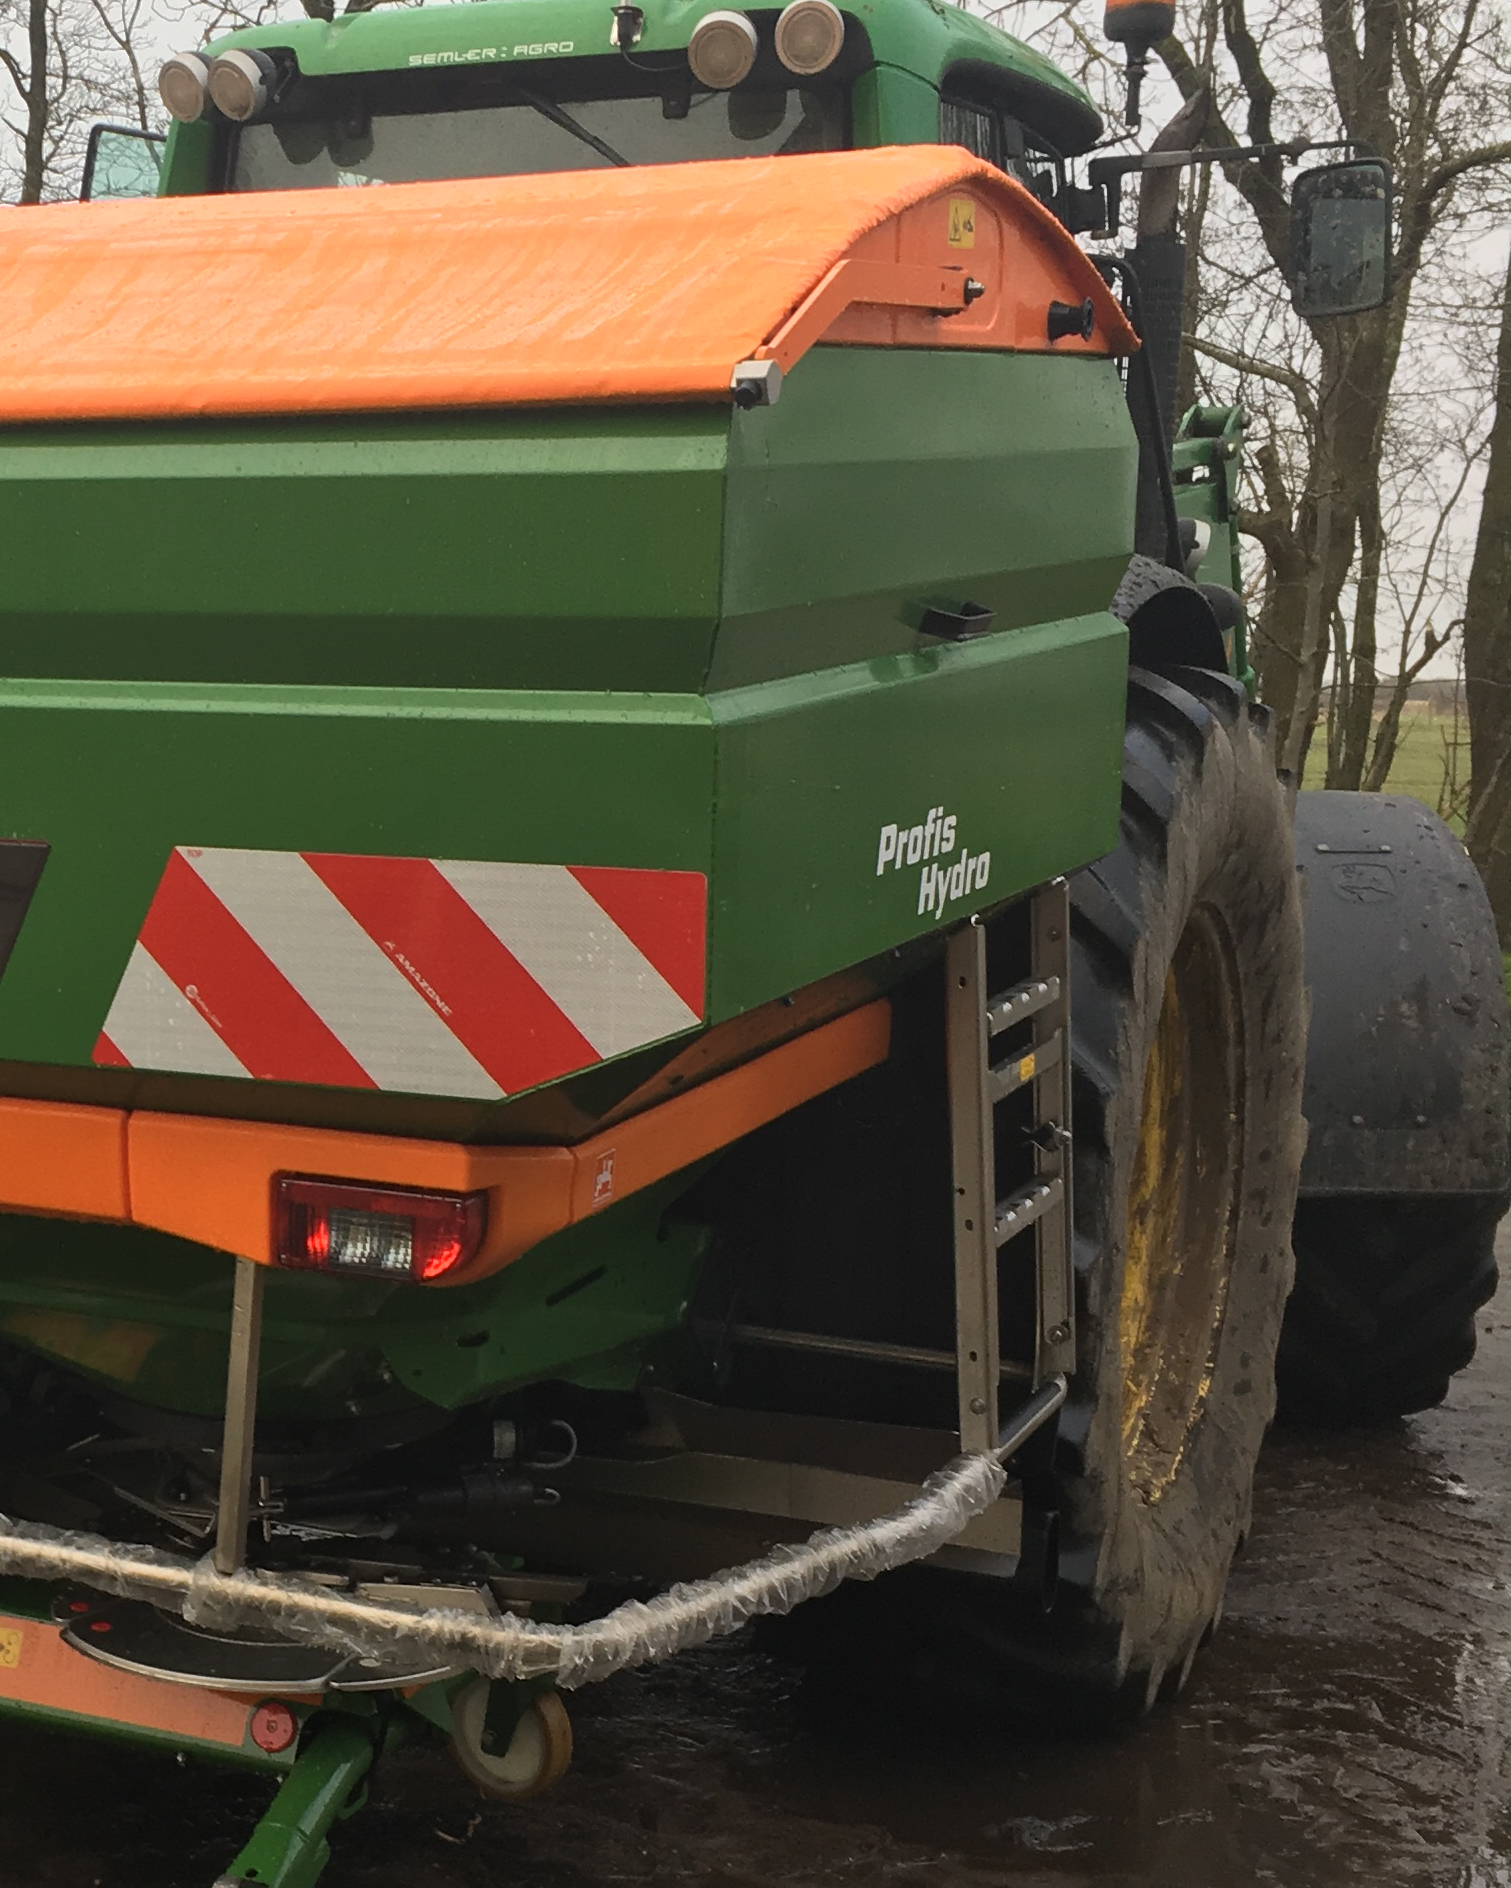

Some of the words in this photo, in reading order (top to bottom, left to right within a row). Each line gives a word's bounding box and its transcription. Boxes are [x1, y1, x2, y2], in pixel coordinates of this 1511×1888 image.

[409, 47, 497, 66] SEMLER
[513, 41, 574, 56] AGRO
[877, 806, 957, 876] Profis
[918, 848, 990, 920] Hydro
[395, 953, 453, 1016] AMAZONE
